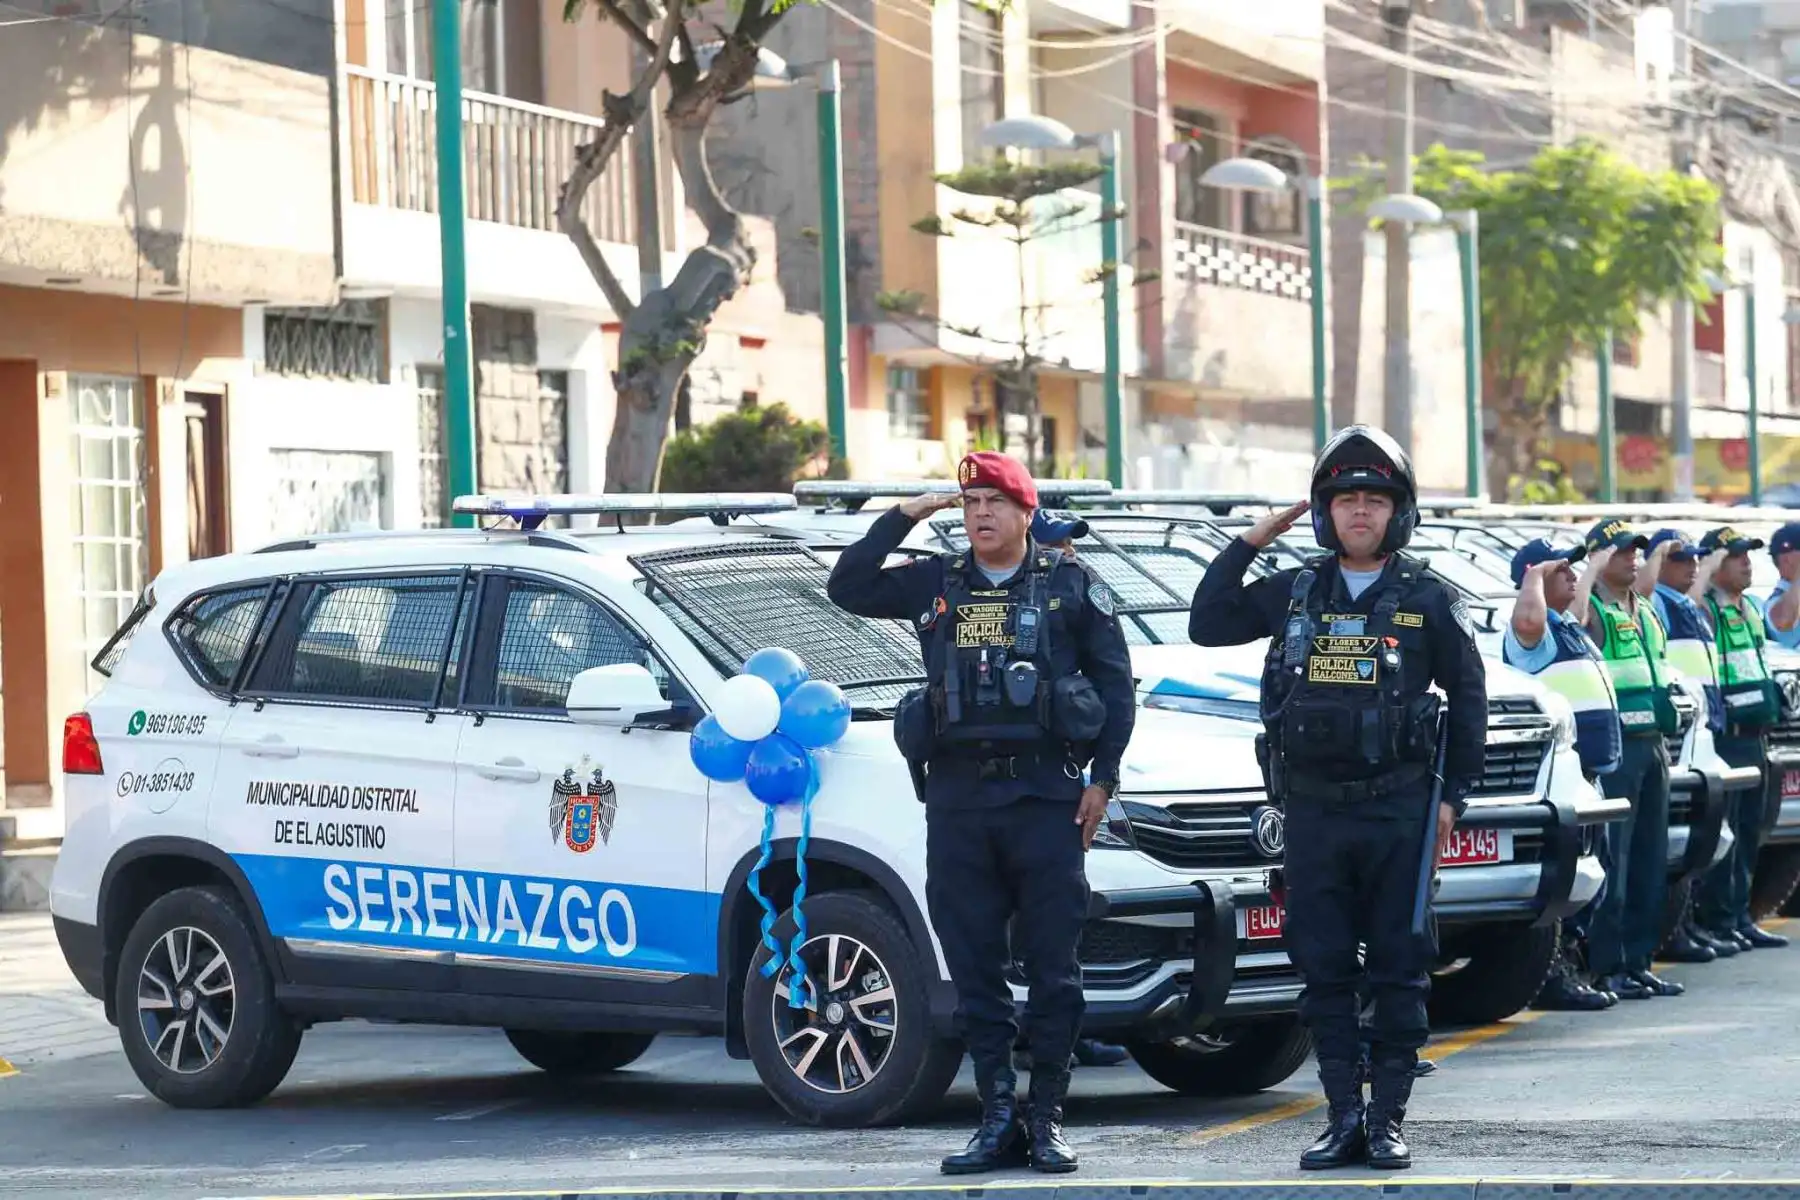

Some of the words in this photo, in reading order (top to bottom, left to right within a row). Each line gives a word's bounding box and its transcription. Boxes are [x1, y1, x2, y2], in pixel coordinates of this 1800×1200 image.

[960, 623, 1004, 637] POLICIA
[1329, 639, 1360, 647] FLORES
[1313, 659, 1357, 672] POLICIA
[1313, 671, 1359, 680] HALCONES
[133, 771, 195, 793] 01-3851438
[247, 781, 350, 809] MUNICIPALIDAD
[351, 786, 420, 813] DISTRITAL
[274, 820, 294, 844] DE
[297, 821, 313, 845] EL
[315, 822, 386, 849] AGUSTINO
[1442, 829, 1497, 858] UJ-145
[323, 864, 637, 956] SERENAZGO
[1251, 906, 1286, 930] EUJ-
